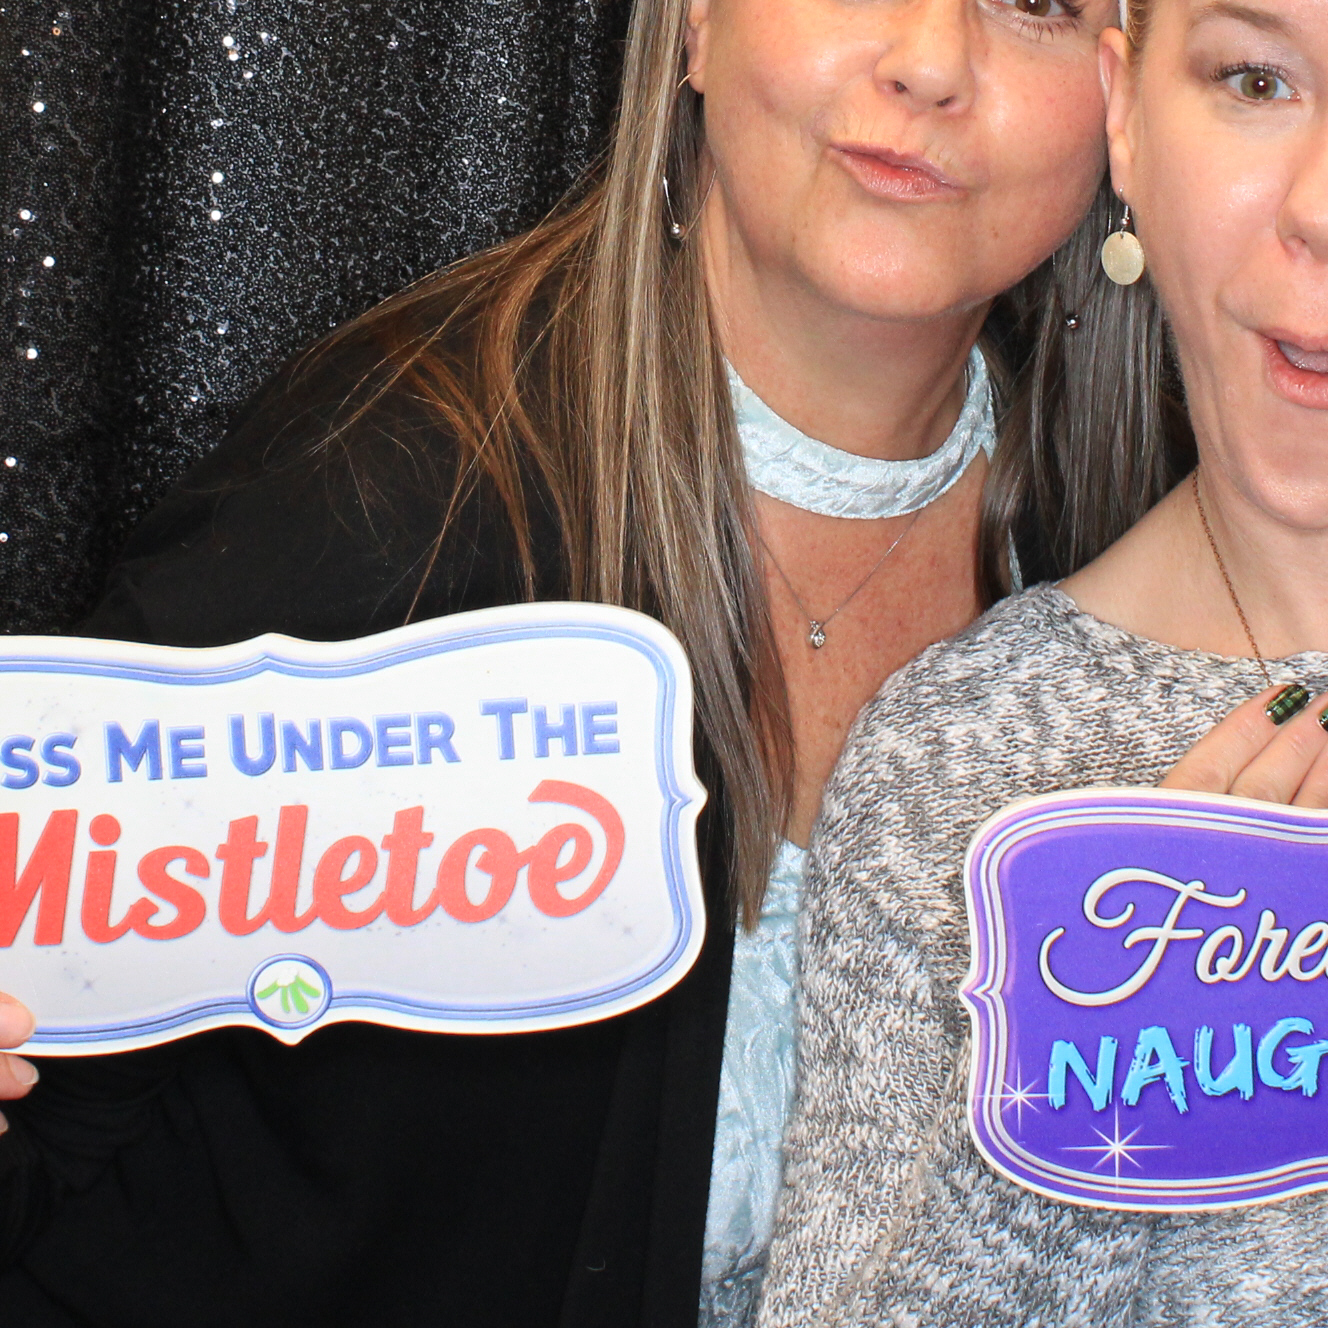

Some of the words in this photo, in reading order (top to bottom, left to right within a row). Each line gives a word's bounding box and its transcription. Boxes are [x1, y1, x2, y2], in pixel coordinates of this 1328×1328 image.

[103, 719, 207, 783] ME
[229, 711, 461, 776] UNDER
[480, 697, 621, 760] THE
